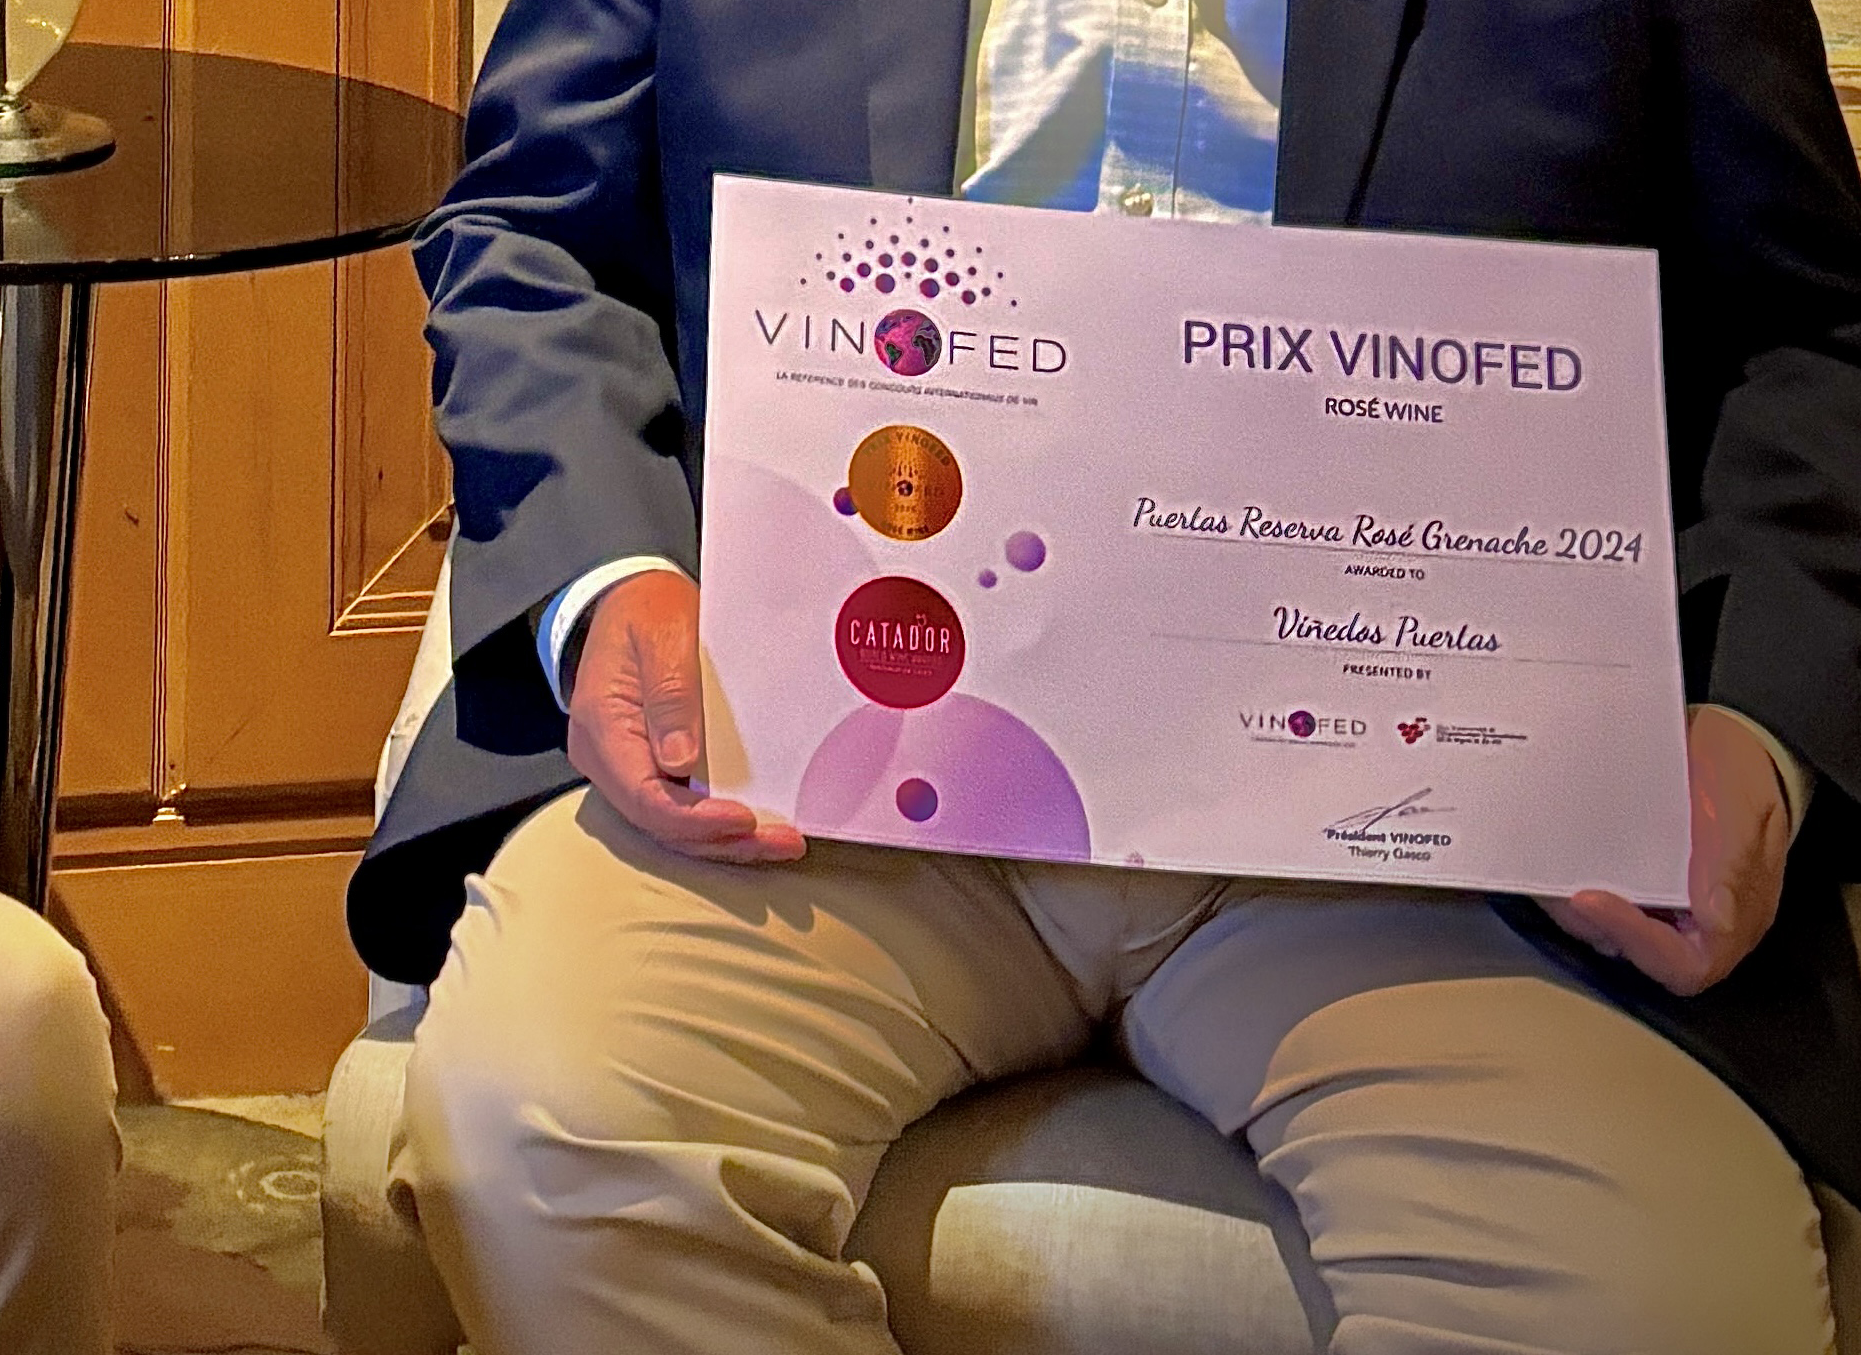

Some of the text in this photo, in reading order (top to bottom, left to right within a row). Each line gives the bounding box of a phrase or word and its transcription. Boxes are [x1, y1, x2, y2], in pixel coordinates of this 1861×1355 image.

[1184, 320, 1582, 391] PRIX VINOFED
[1325, 397, 1444, 424] ROSÉ WINE
[1239, 506, 1345, 543] Reserva
[1352, 514, 1415, 548] Rosé
[1422, 520, 1548, 556] Grenache
[1555, 528, 1643, 563] 2024
[1344, 564, 1425, 581] AWARDED TO
[1273, 606, 1386, 645] Viñedos
[1343, 664, 1432, 680] PRESENTED BY
[1390, 832, 1452, 846] VINOFED
